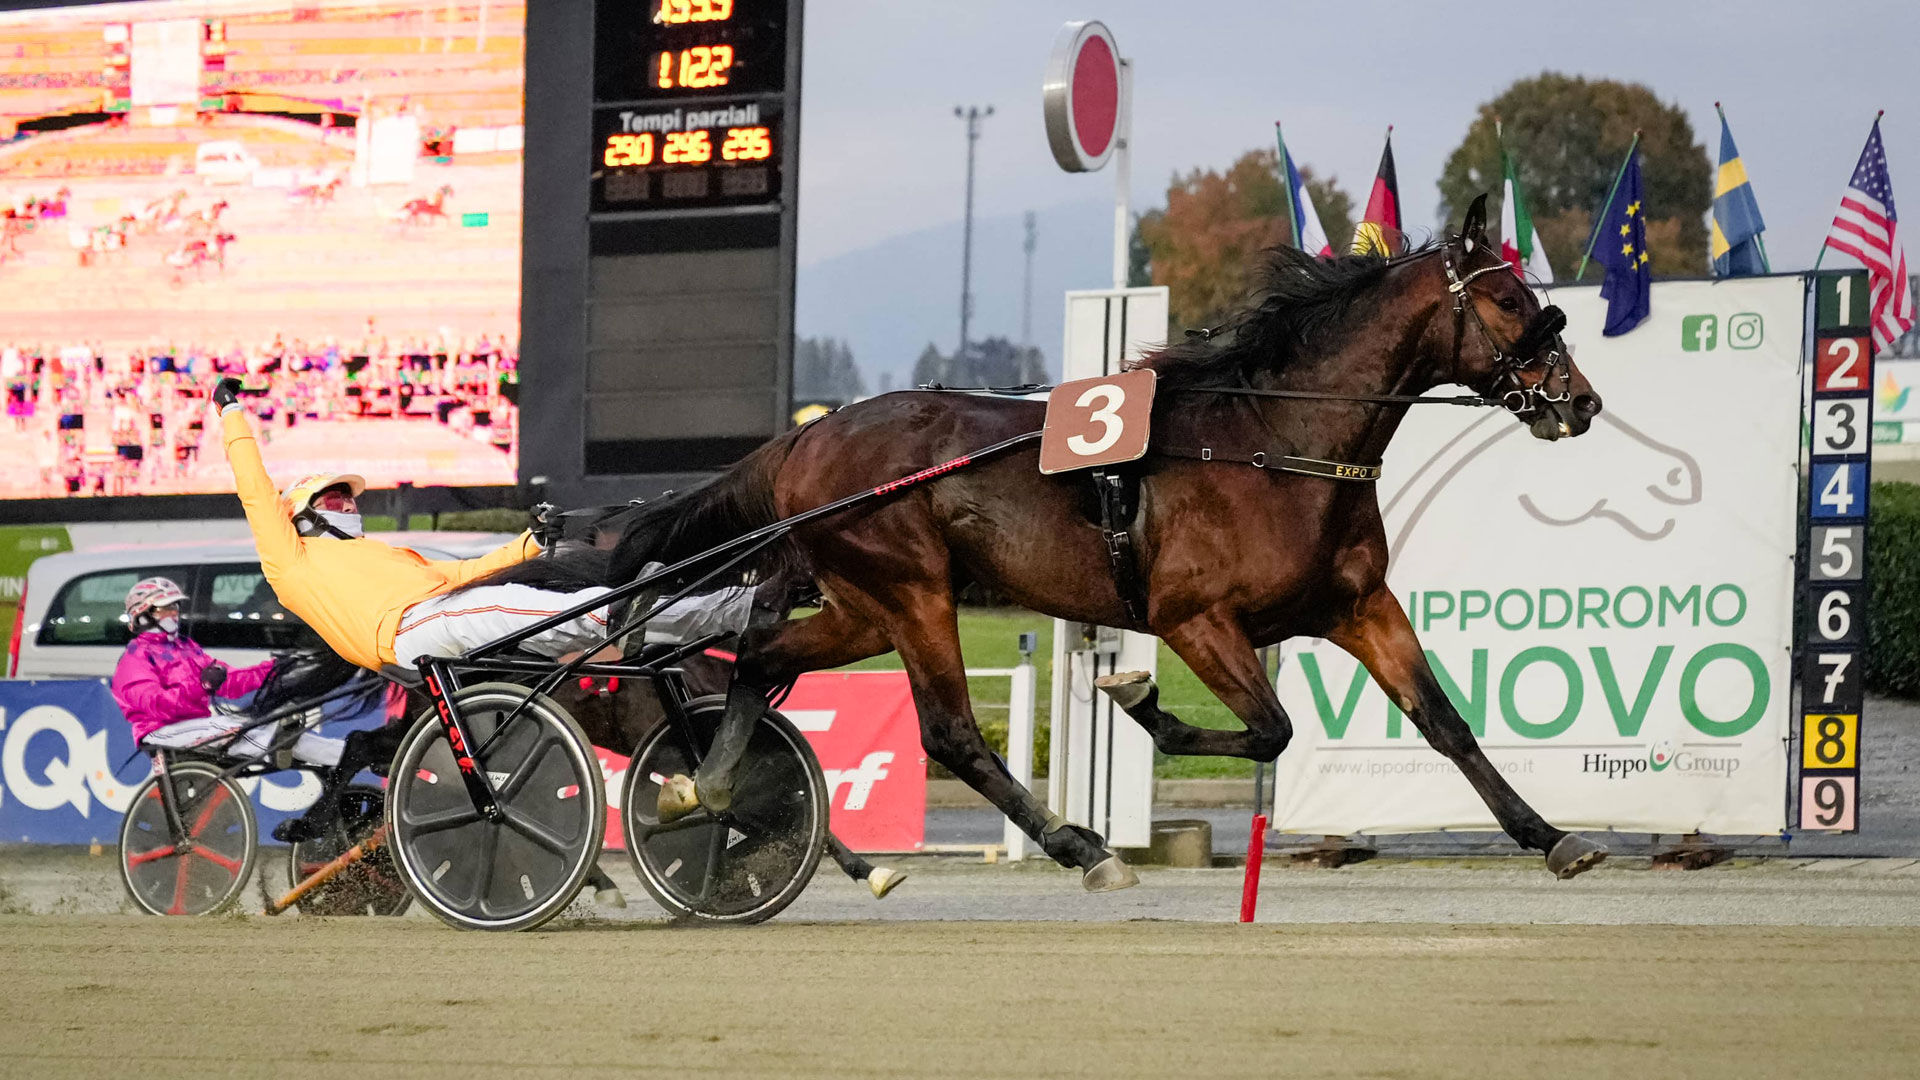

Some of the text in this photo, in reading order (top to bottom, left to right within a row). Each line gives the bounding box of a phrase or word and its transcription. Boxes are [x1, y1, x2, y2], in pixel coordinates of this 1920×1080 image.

[619, 104, 760, 132] Tempi parziali
[604, 133, 655, 167] 290
[1836, 276, 1851, 326] 1
[1826, 338, 1859, 388] 2
[1066, 384, 1126, 456] 3
[1825, 403, 1856, 450] 3
[1336, 465, 1368, 478] EXPO
[1820, 464, 1853, 514] 4
[1820, 528, 1853, 578] 5
[1408, 583, 1747, 632] IPPODROMO
[1818, 590, 1851, 640] 6
[1818, 653, 1851, 703] 7
[1815, 716, 1846, 765] 8
[1583, 751, 1741, 780] Hippo Group
[1814, 779, 1845, 827] 9
